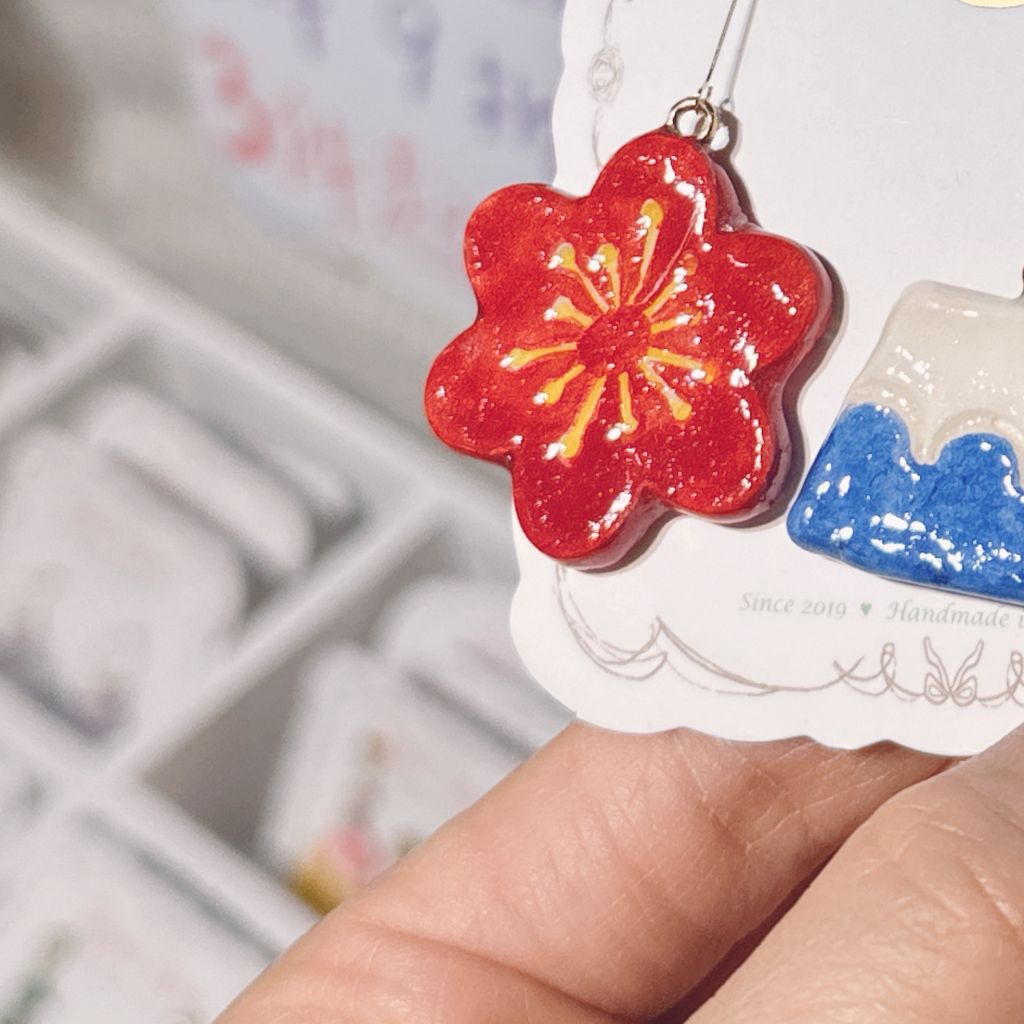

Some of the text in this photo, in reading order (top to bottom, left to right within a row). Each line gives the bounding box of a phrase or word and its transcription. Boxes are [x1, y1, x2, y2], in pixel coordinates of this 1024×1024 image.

[739, 592, 796, 615] Since
[800, 599, 848, 621] 2019
[885, 599, 1010, 630] Handmade
